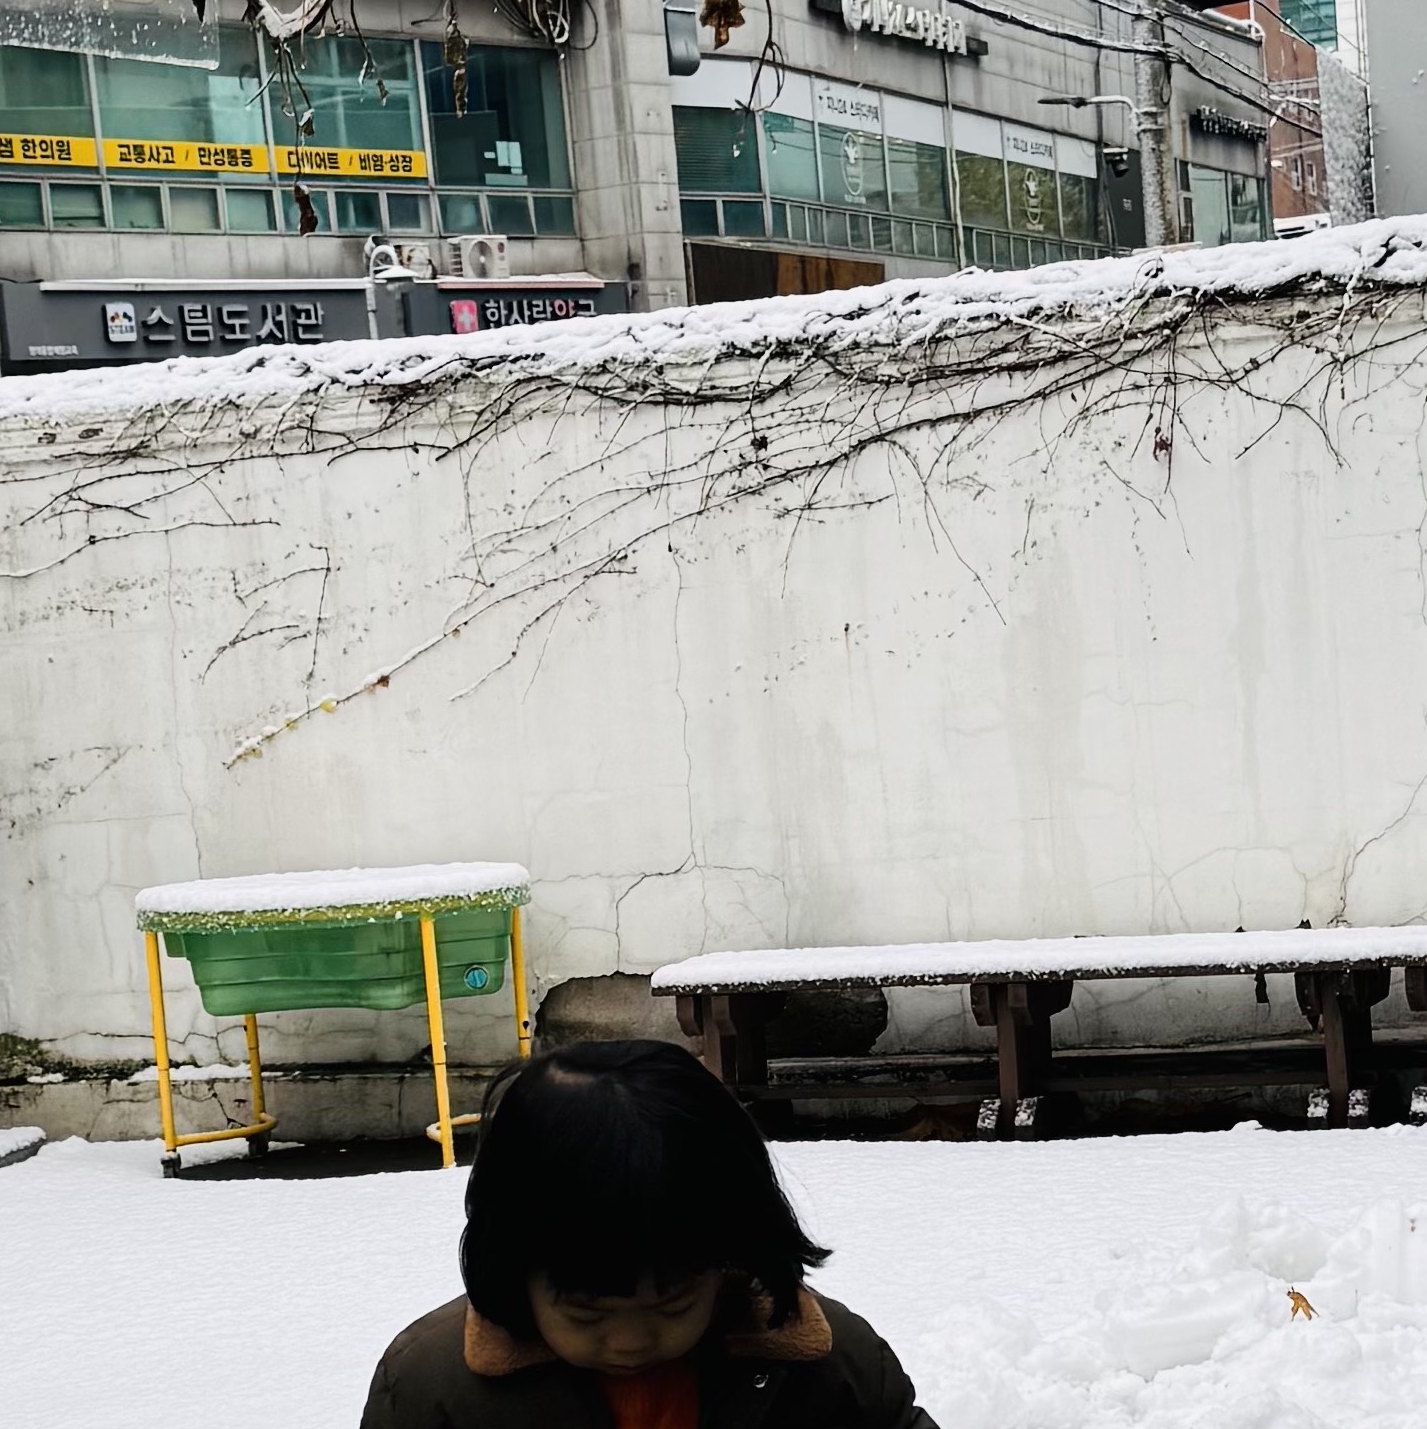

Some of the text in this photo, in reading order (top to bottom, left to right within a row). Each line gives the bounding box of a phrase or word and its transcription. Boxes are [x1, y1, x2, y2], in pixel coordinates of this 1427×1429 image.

[21, 138, 72, 161] 한의원
[118, 144, 175, 164] 교통사고
[287, 150, 341, 170] 다이어트
[145, 302, 324, 342] 스팀도서관
